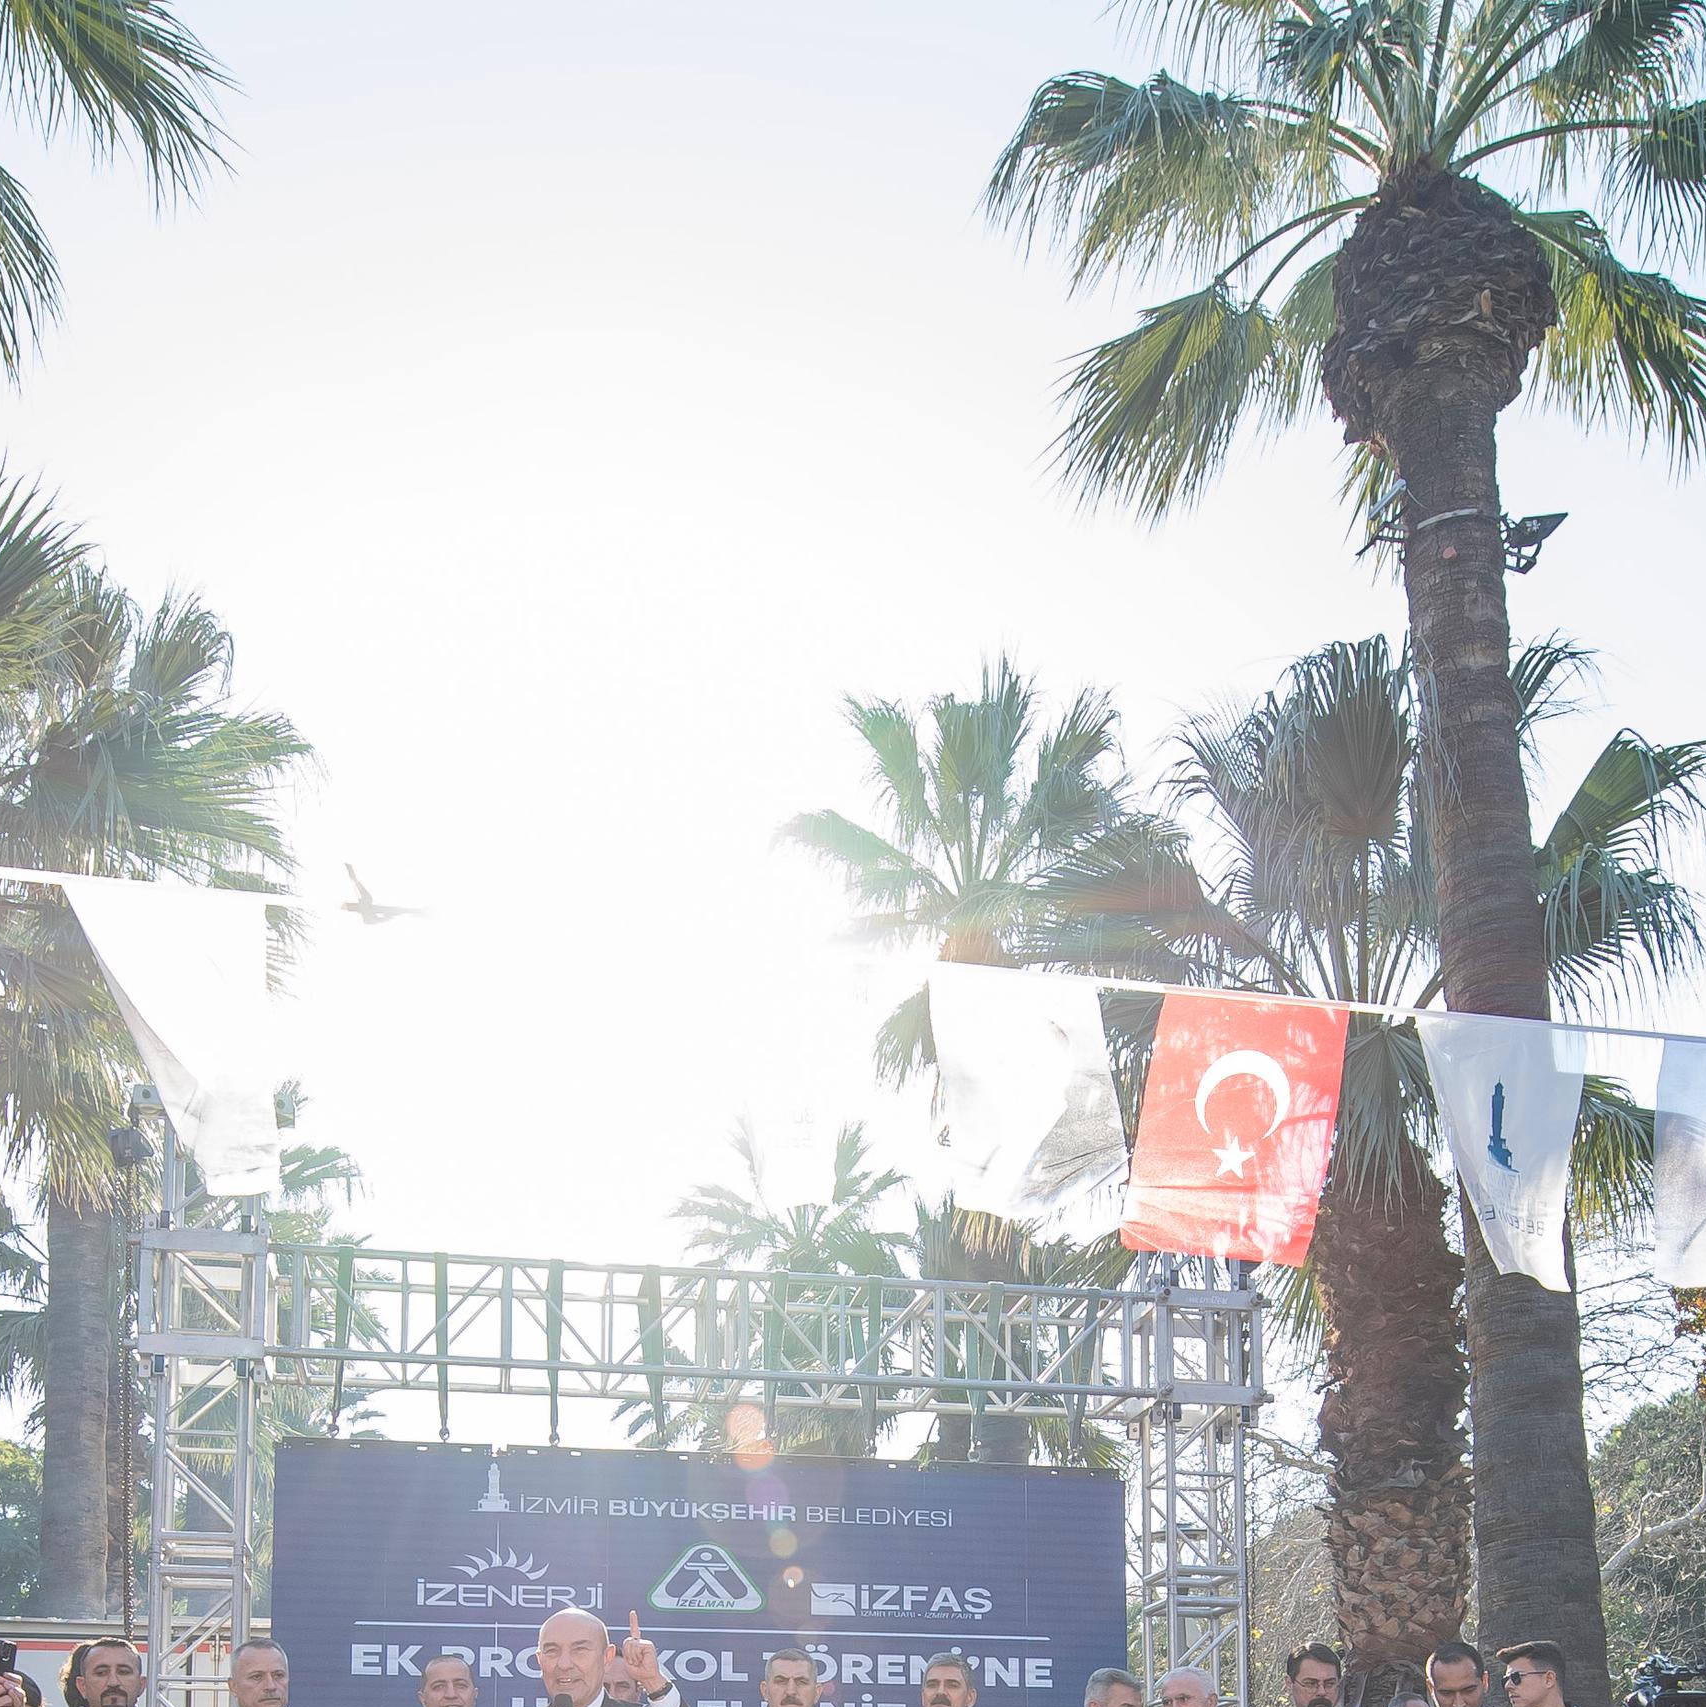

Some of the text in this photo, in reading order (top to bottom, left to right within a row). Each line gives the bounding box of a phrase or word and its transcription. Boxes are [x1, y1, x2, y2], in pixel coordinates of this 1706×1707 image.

[519, 1494, 953, 1527] İZMİR BÜYÜKŞEHİR BELEDİYESİ
[860, 1584, 993, 1619] İZFAŞ
[351, 1643, 424, 1676] EK
